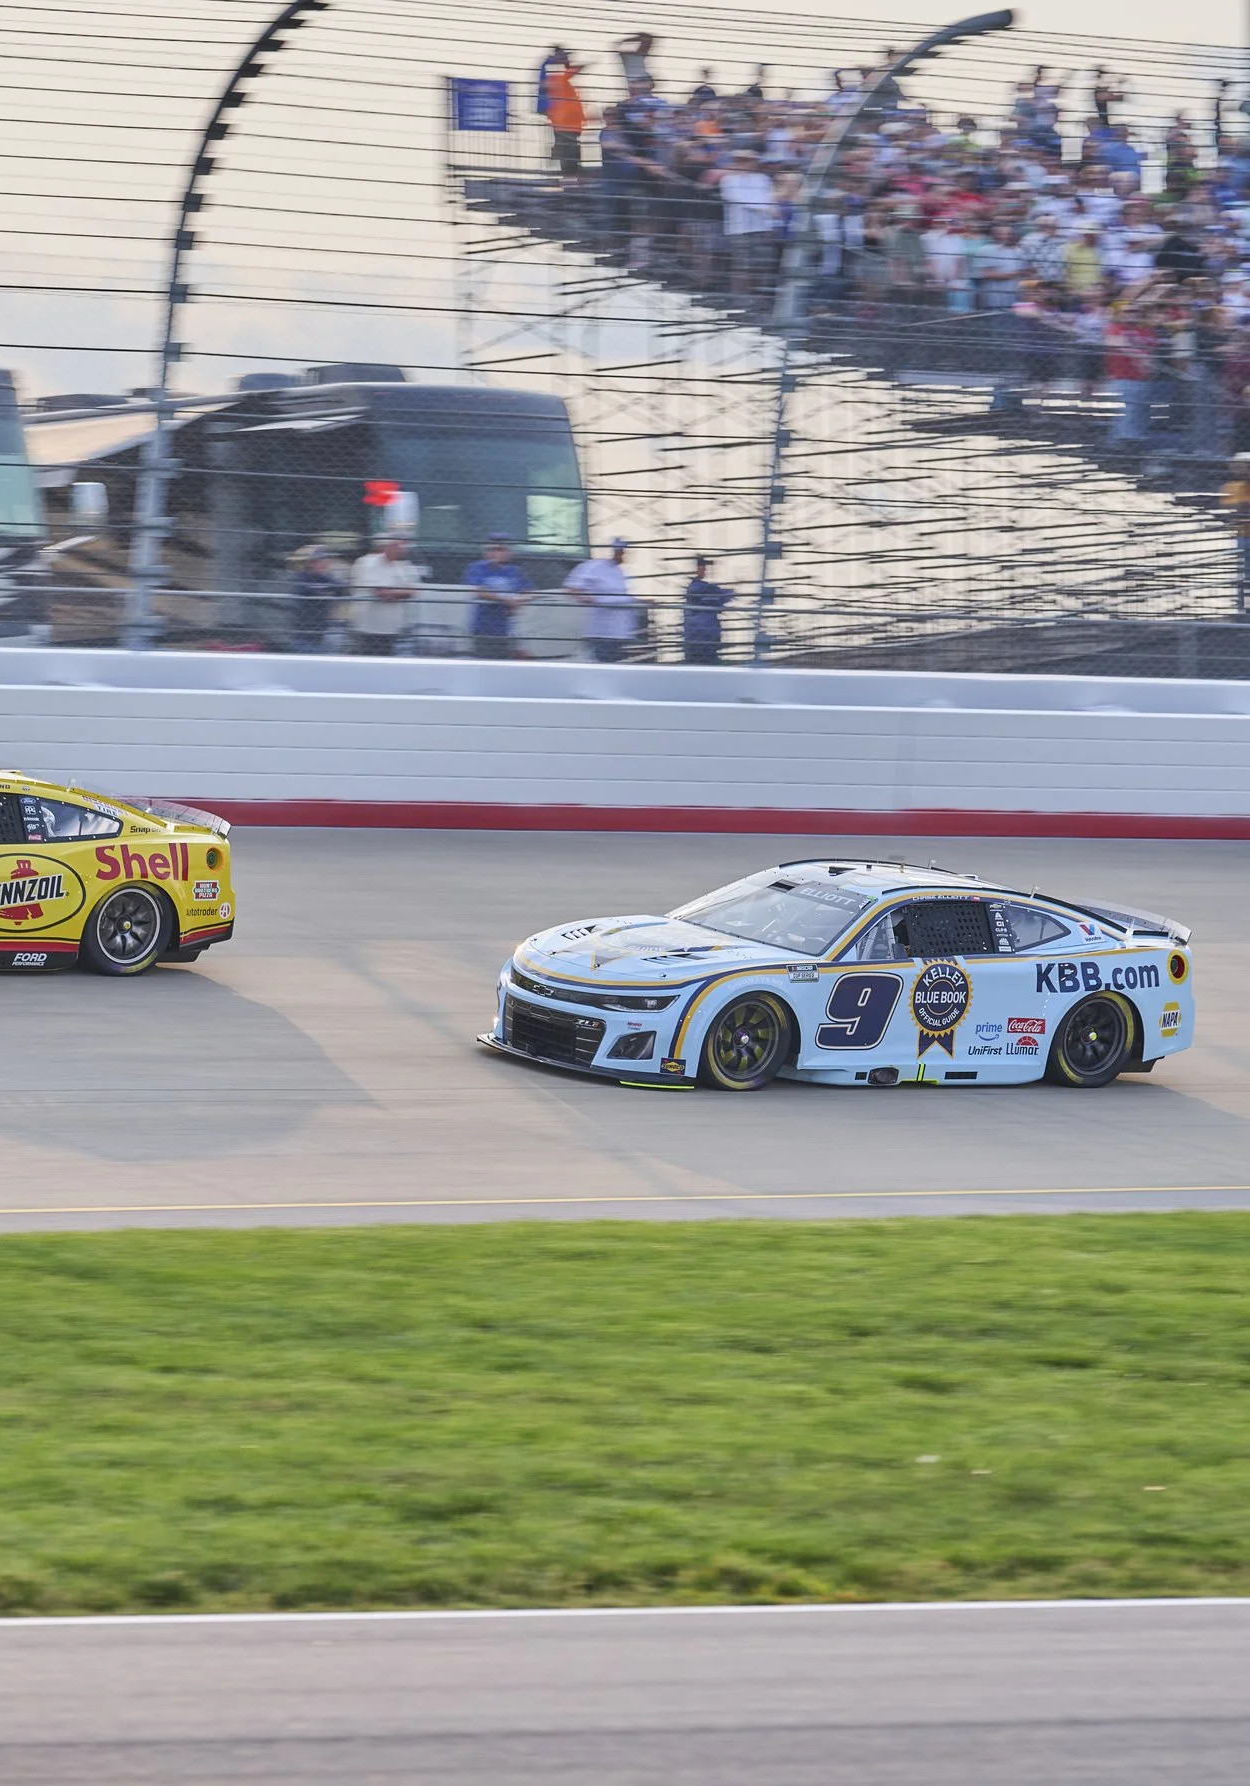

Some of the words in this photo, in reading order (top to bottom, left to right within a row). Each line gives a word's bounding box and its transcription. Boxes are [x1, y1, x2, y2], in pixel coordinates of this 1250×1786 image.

[130, 825, 161, 834] Snapon
[95, 842, 189, 882] Shell
[799, 887, 857, 906] ELLIOTT
[13, 953, 47, 962] FORD
[922, 966, 965, 987] KELLEY
[1035, 961, 1160, 993] KBB.com
[915, 991, 940, 1004] BLUE
[940, 991, 967, 1004] BOOK
[815, 972, 904, 1050] 9
[918, 1007, 942, 1027] OFFICIAL
[942, 1007, 960, 1025] GUIDE
[1161, 1011, 1179, 1028] NAPA
[975, 1022, 1003, 1034] prime
[967, 1046, 1003, 1056] UniFirst
